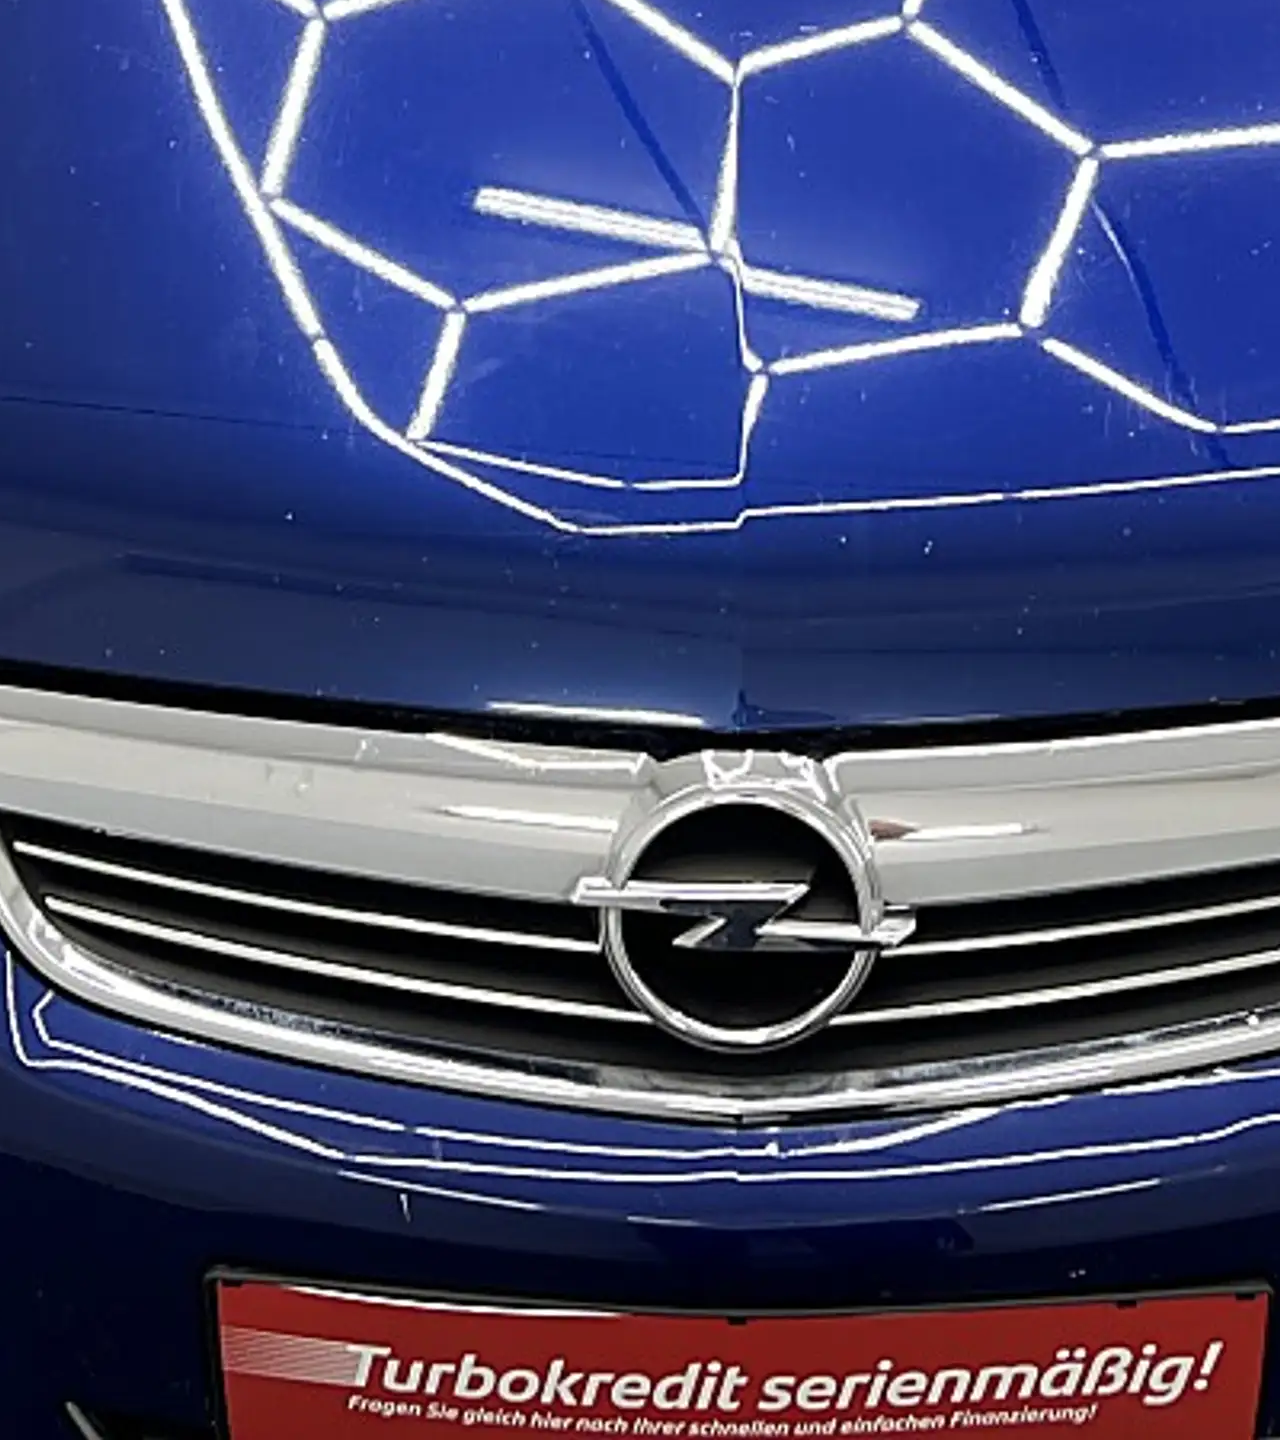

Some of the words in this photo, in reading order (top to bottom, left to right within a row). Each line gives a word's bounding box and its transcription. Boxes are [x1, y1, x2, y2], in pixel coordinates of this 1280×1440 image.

[346, 1343, 748, 1411] Turbokredit
[757, 1340, 1224, 1411] serienmäßig!
[348, 1394, 421, 1419] Fragen
[425, 1403, 459, 1420] Sie
[463, 1407, 524, 1429] gleich
[530, 1409, 572, 1431] hier
[576, 1413, 628, 1432] nach
[633, 1415, 687, 1437] Ihrer
[688, 1417, 789, 1437] schnellen
[794, 1417, 837, 1437] und
[840, 1412, 946, 1435] einfachen
[950, 1401, 1099, 1430] Finanzierung!
